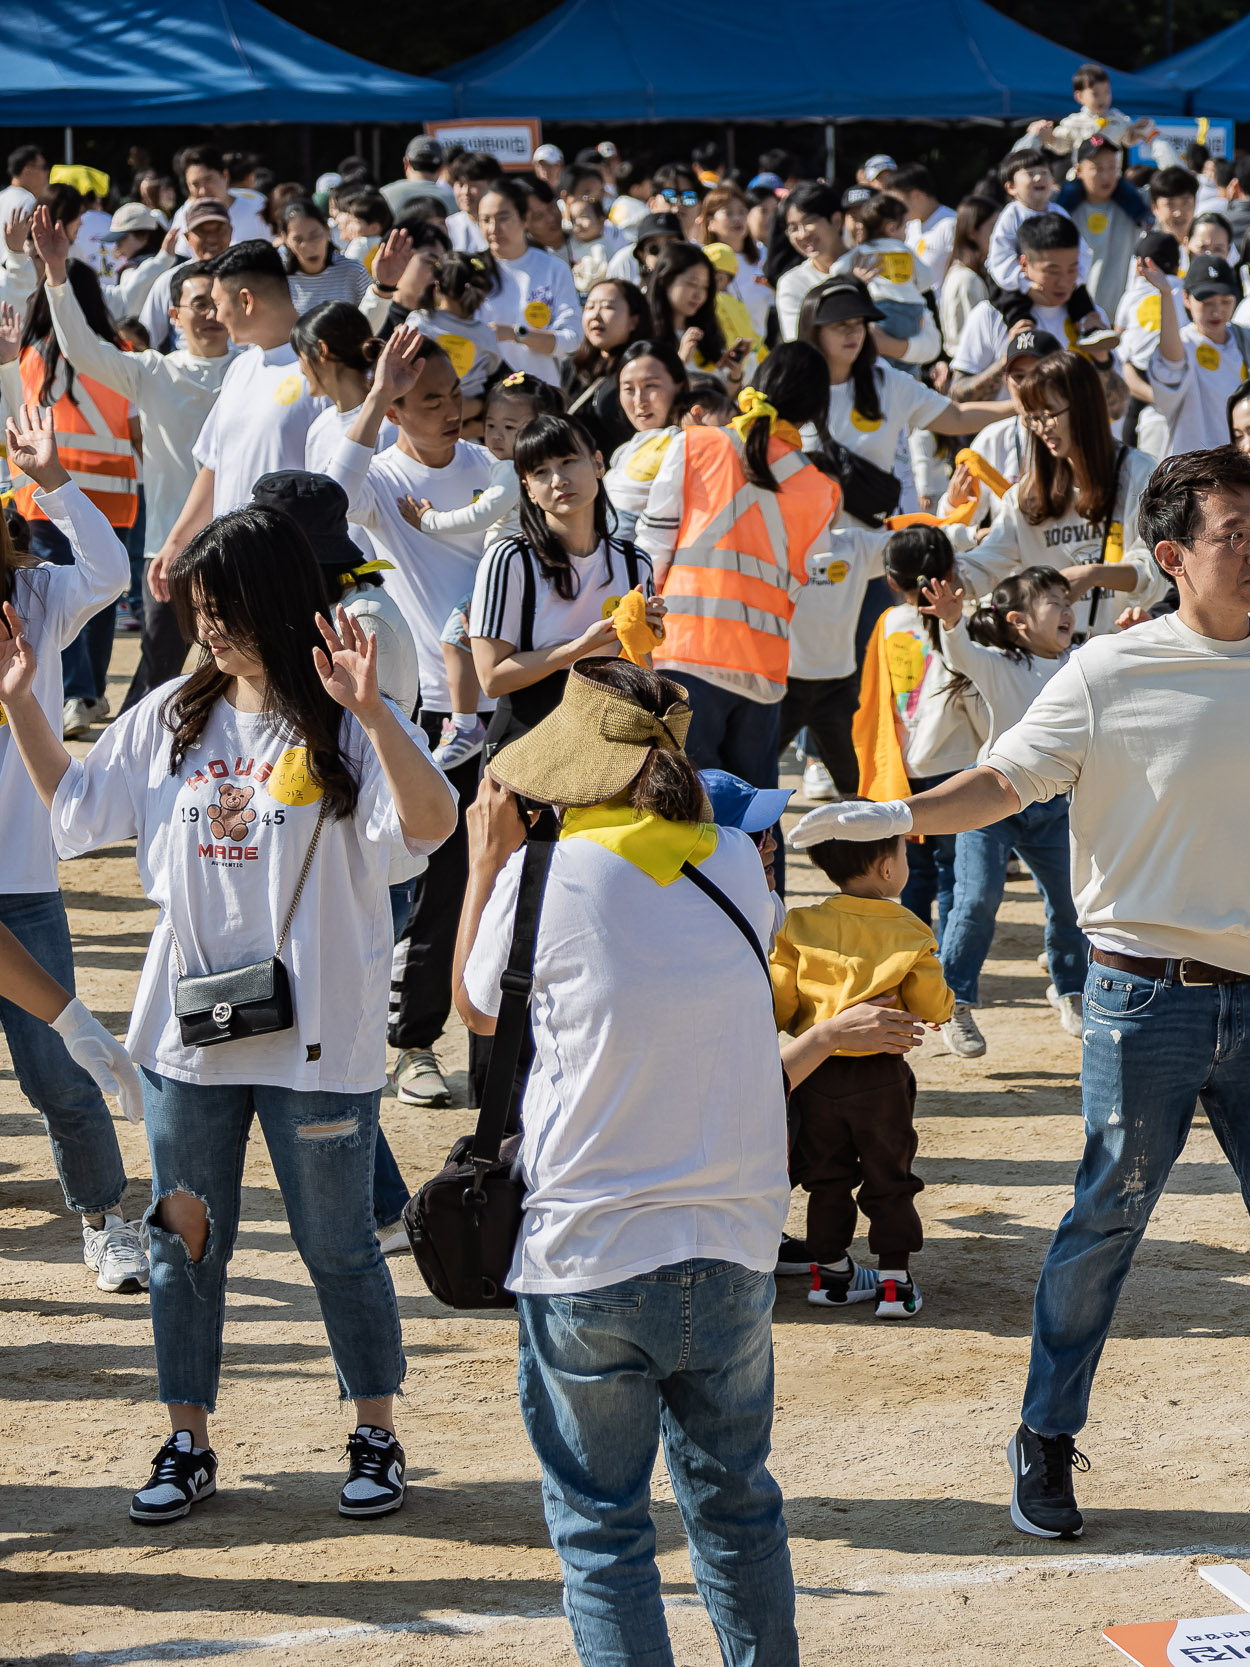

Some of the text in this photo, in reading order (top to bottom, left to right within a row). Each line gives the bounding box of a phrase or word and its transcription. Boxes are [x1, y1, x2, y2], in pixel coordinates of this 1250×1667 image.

[186, 756, 273, 796] HOUS
[286, 789, 304, 800] 가족
[181, 807, 285, 826] 19 45
[198, 844, 259, 860] MADE
